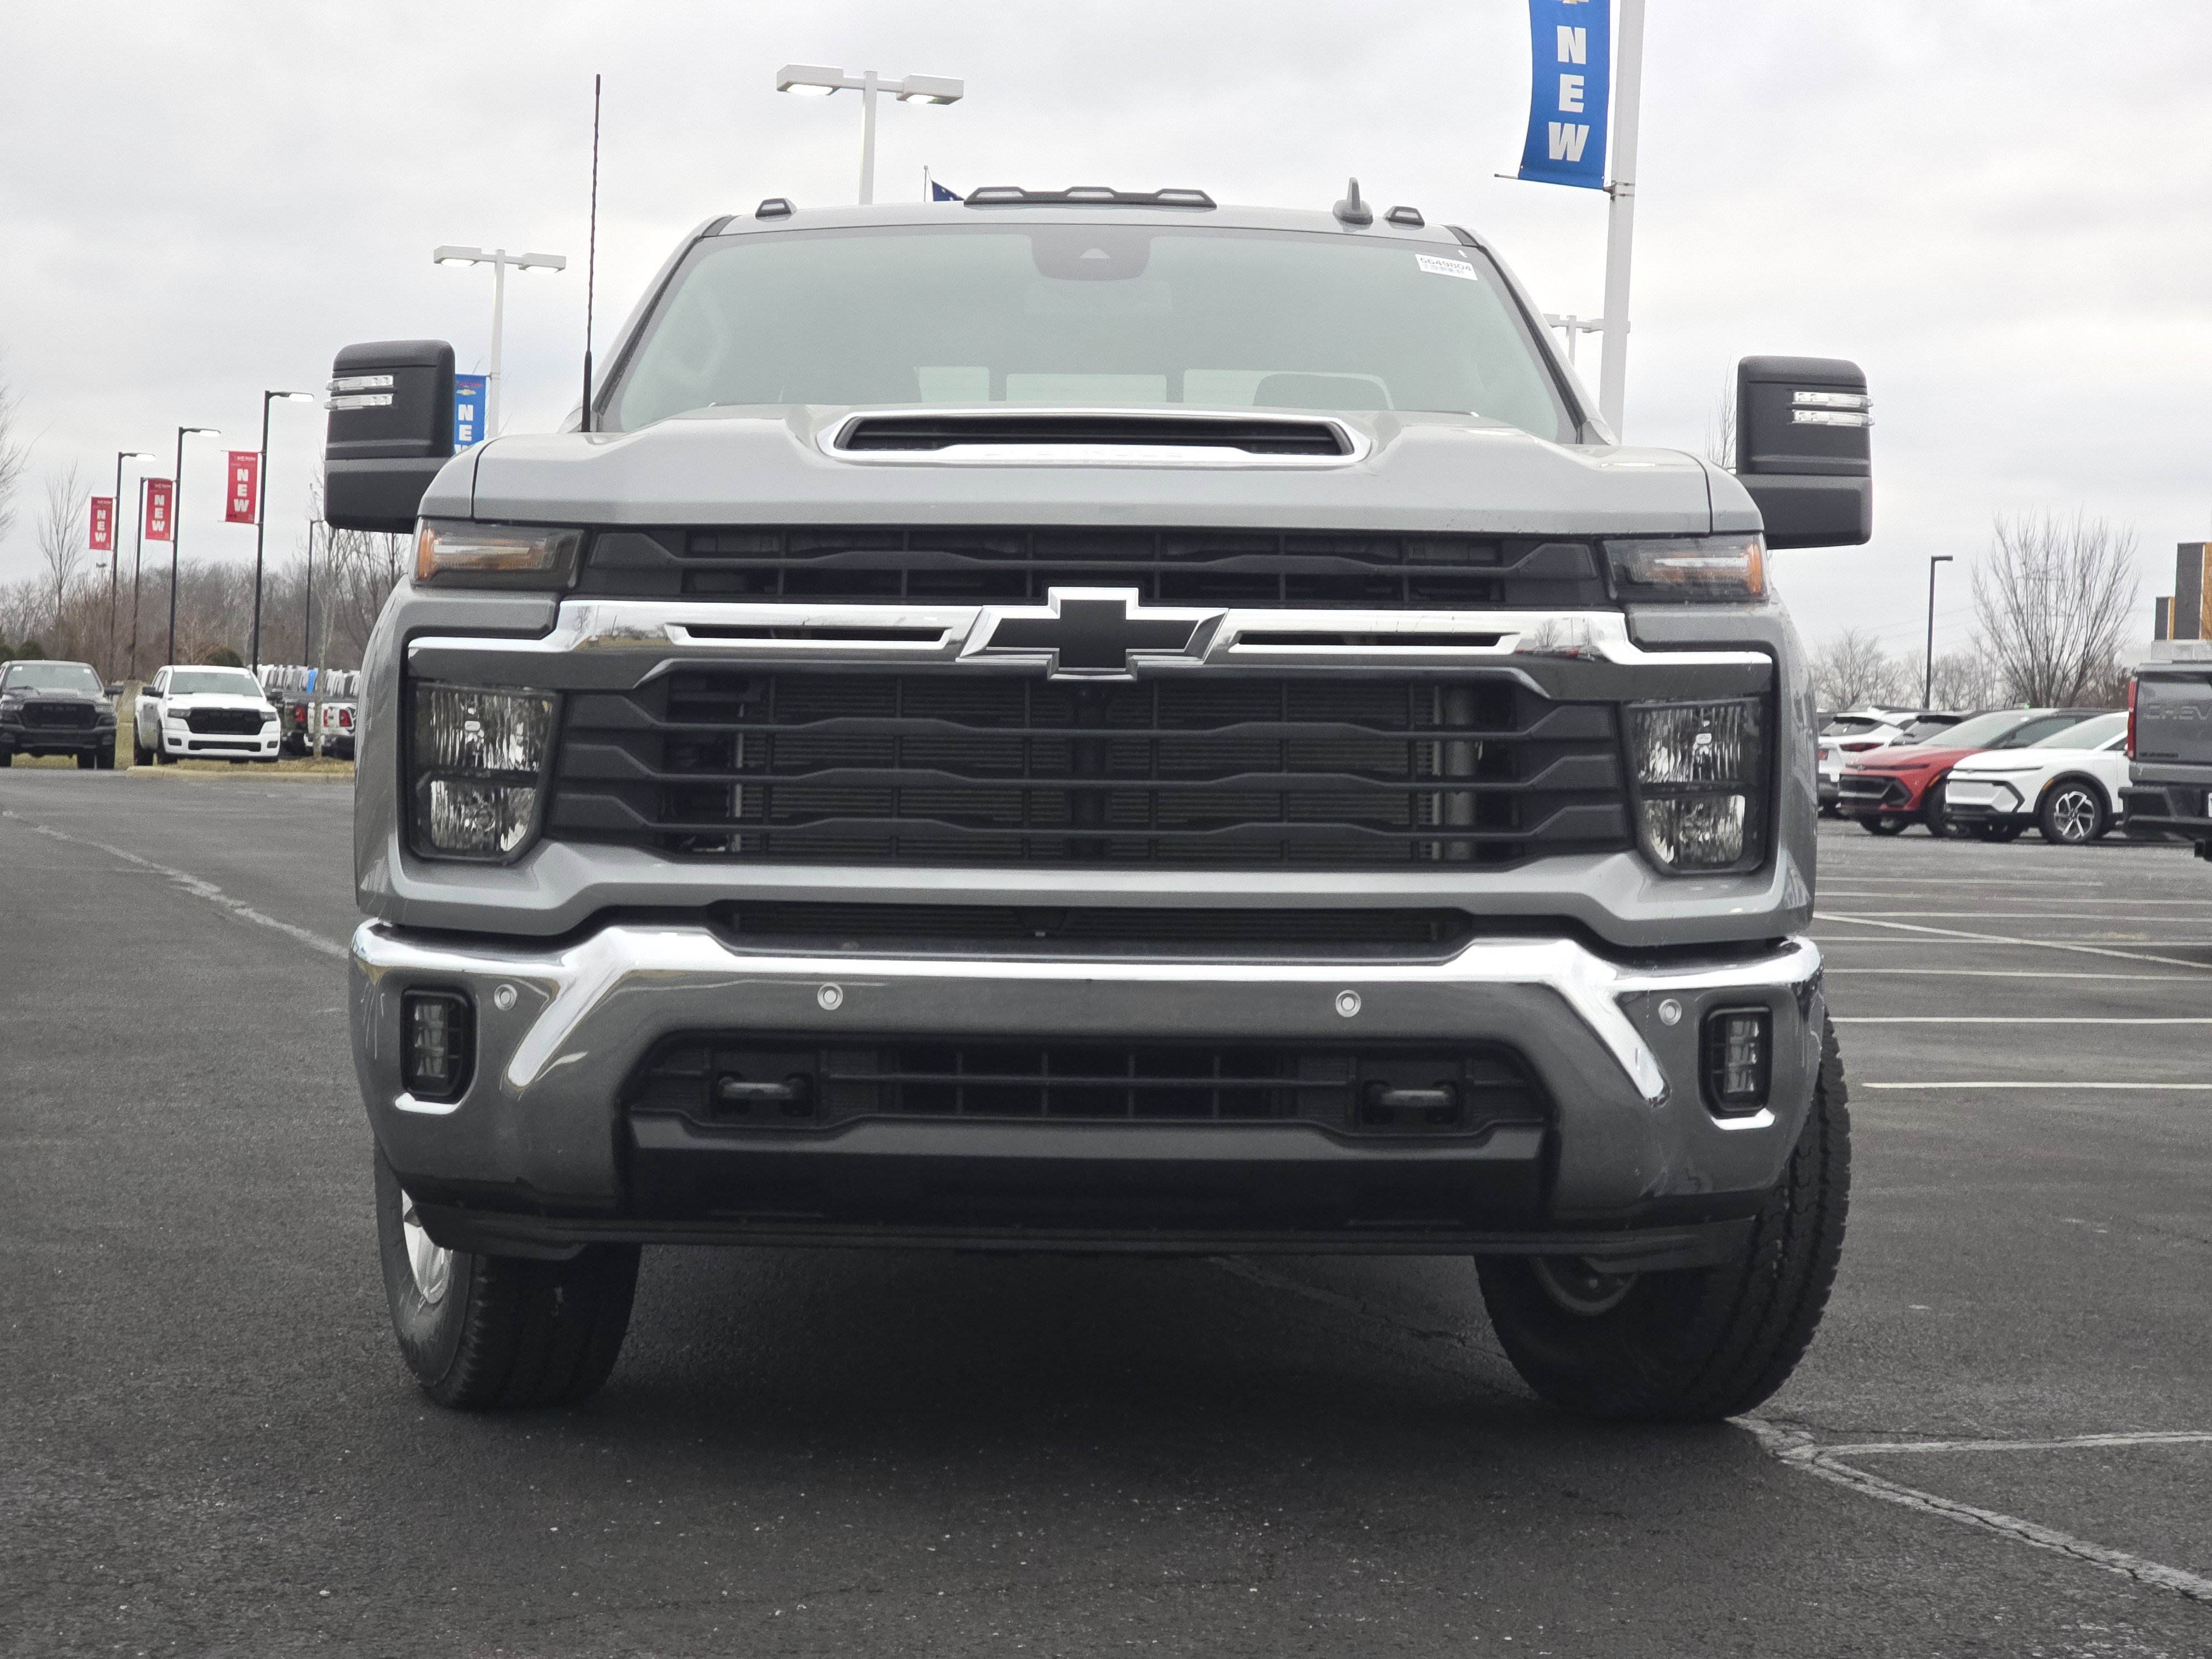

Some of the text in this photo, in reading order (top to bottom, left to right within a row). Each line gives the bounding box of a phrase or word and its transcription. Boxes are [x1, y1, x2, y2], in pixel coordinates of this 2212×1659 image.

[1548, 25, 1590, 162] NEW
[233, 468, 249, 513] NEW
[95, 509, 106, 542] NEW
[152, 494, 165, 532] NEW
